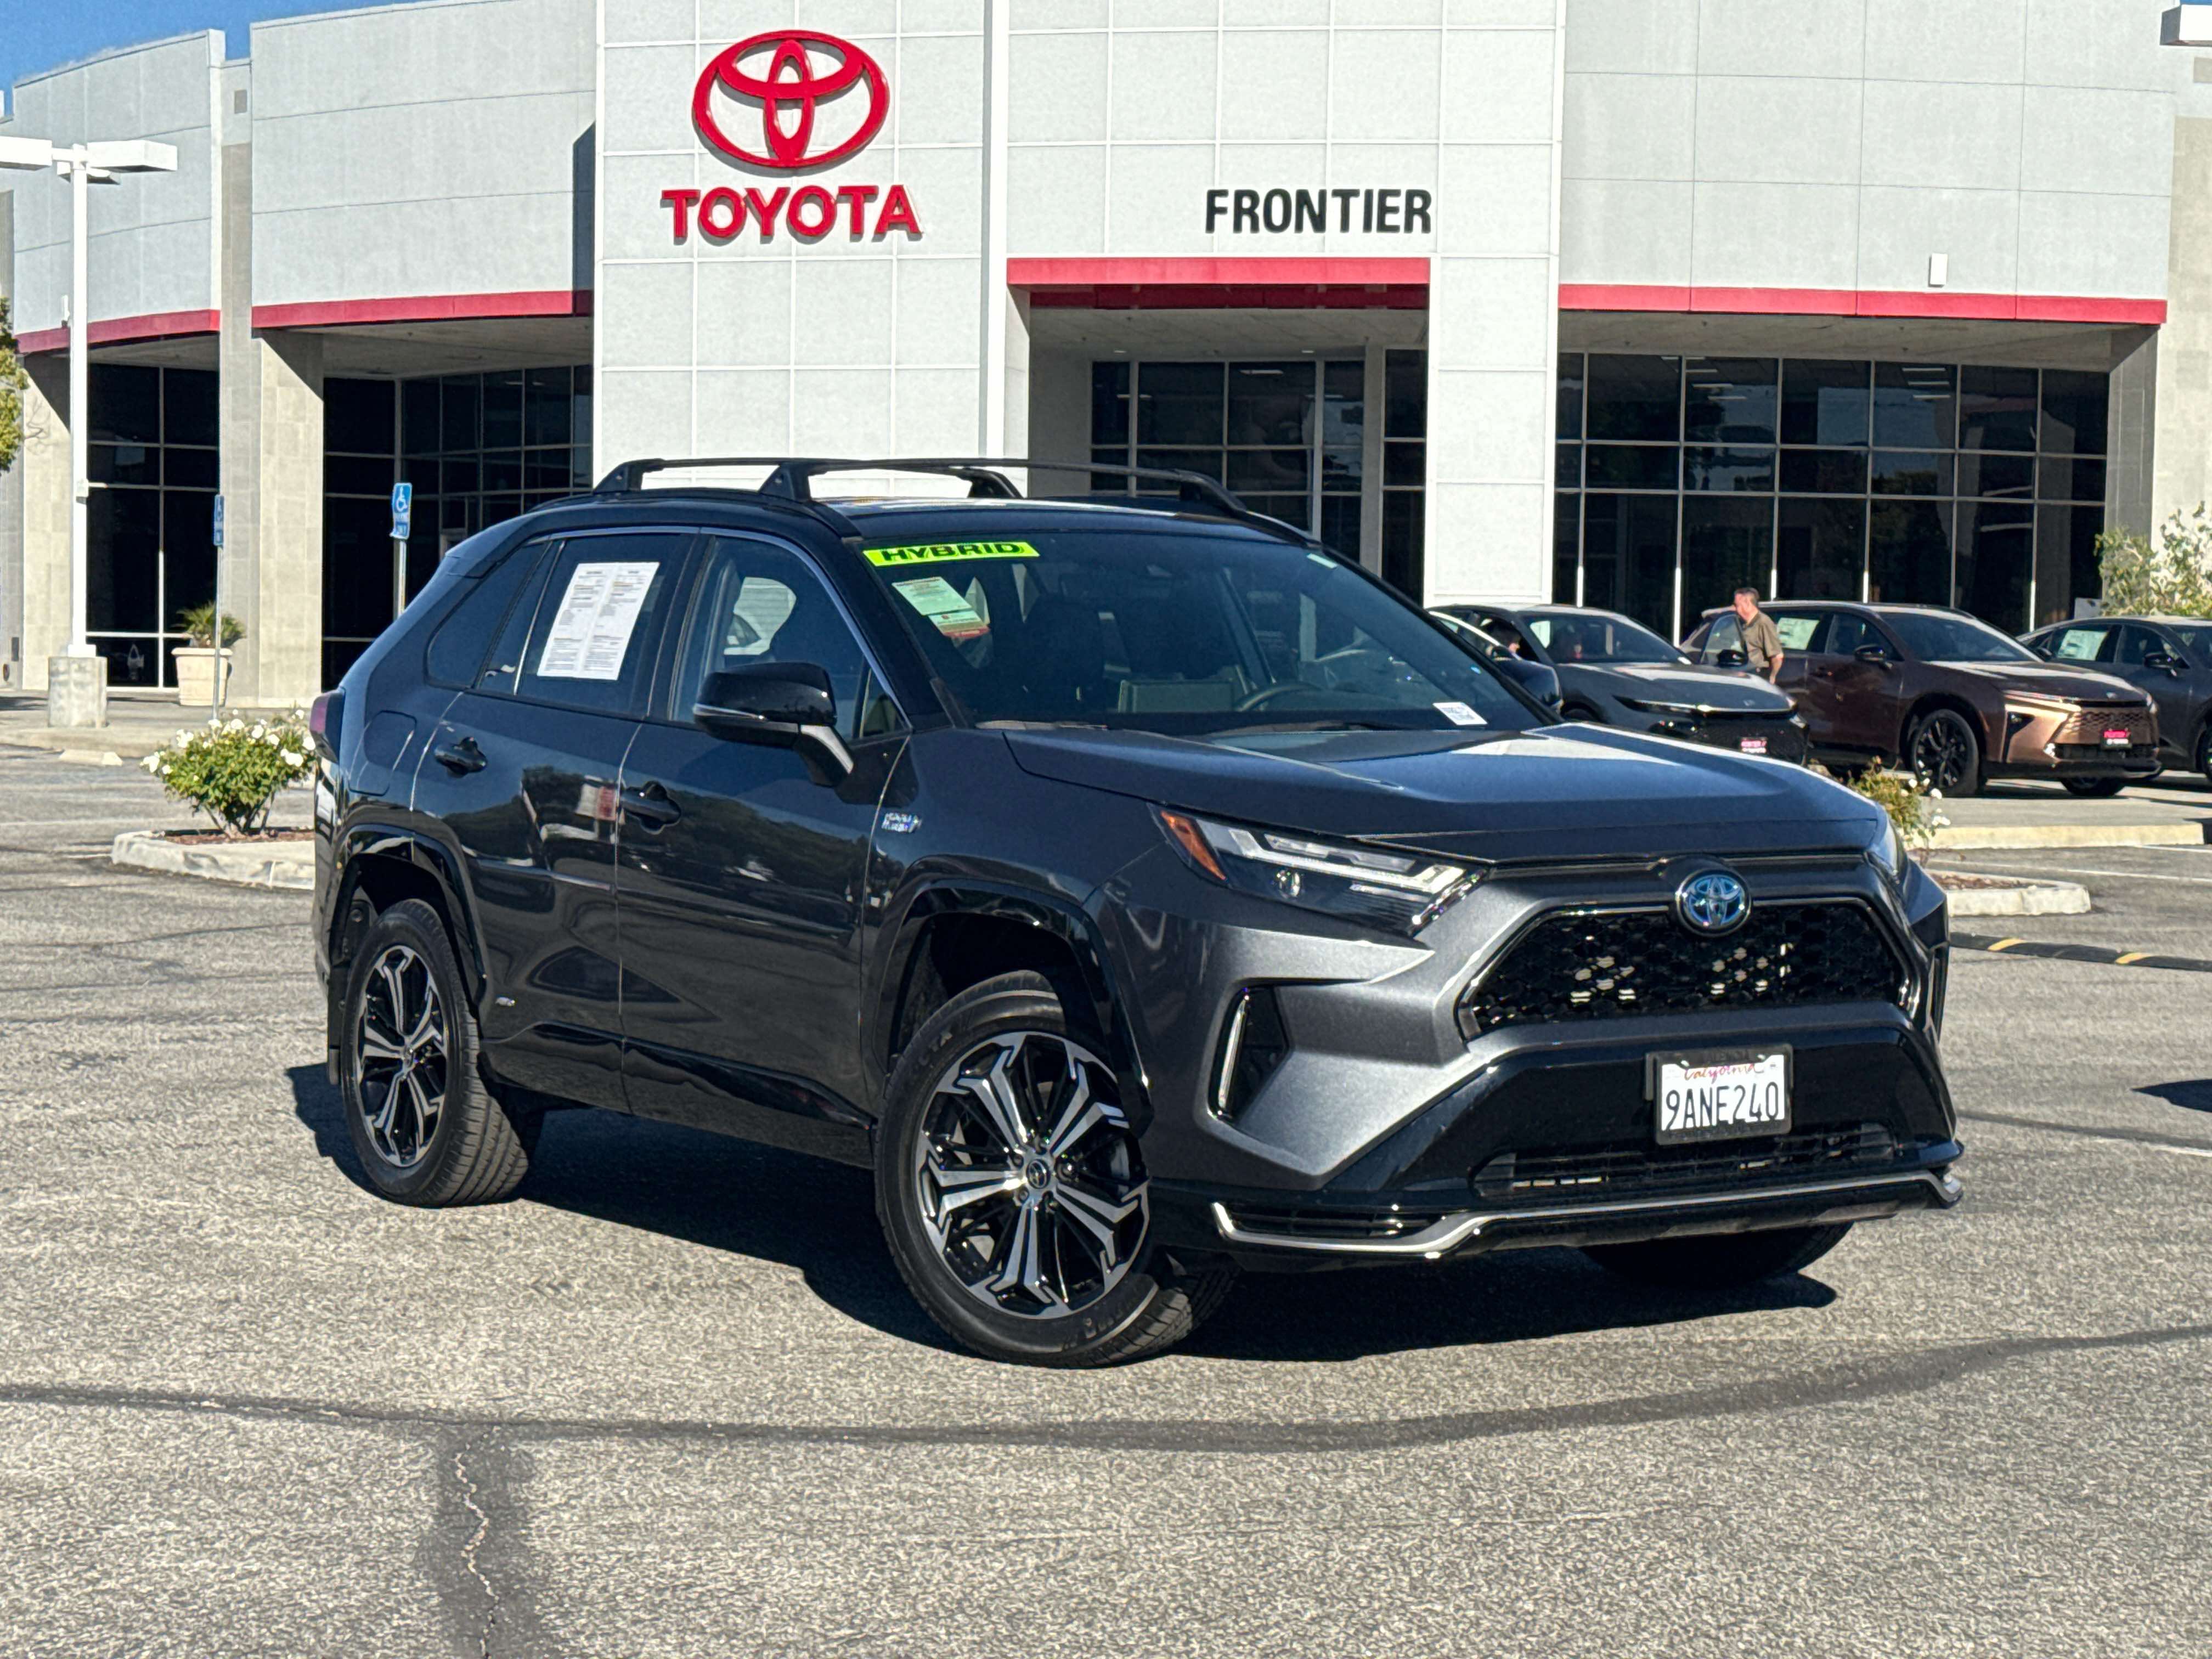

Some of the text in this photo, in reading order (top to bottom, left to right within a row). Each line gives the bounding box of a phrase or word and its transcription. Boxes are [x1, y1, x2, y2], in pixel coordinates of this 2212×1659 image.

[661, 185, 921, 238] TOYOTA
[1205, 188, 1432, 234] FRONTIER
[882, 543, 1023, 562] HYBRID
[1666, 1081, 1779, 1131] 9ANE240
